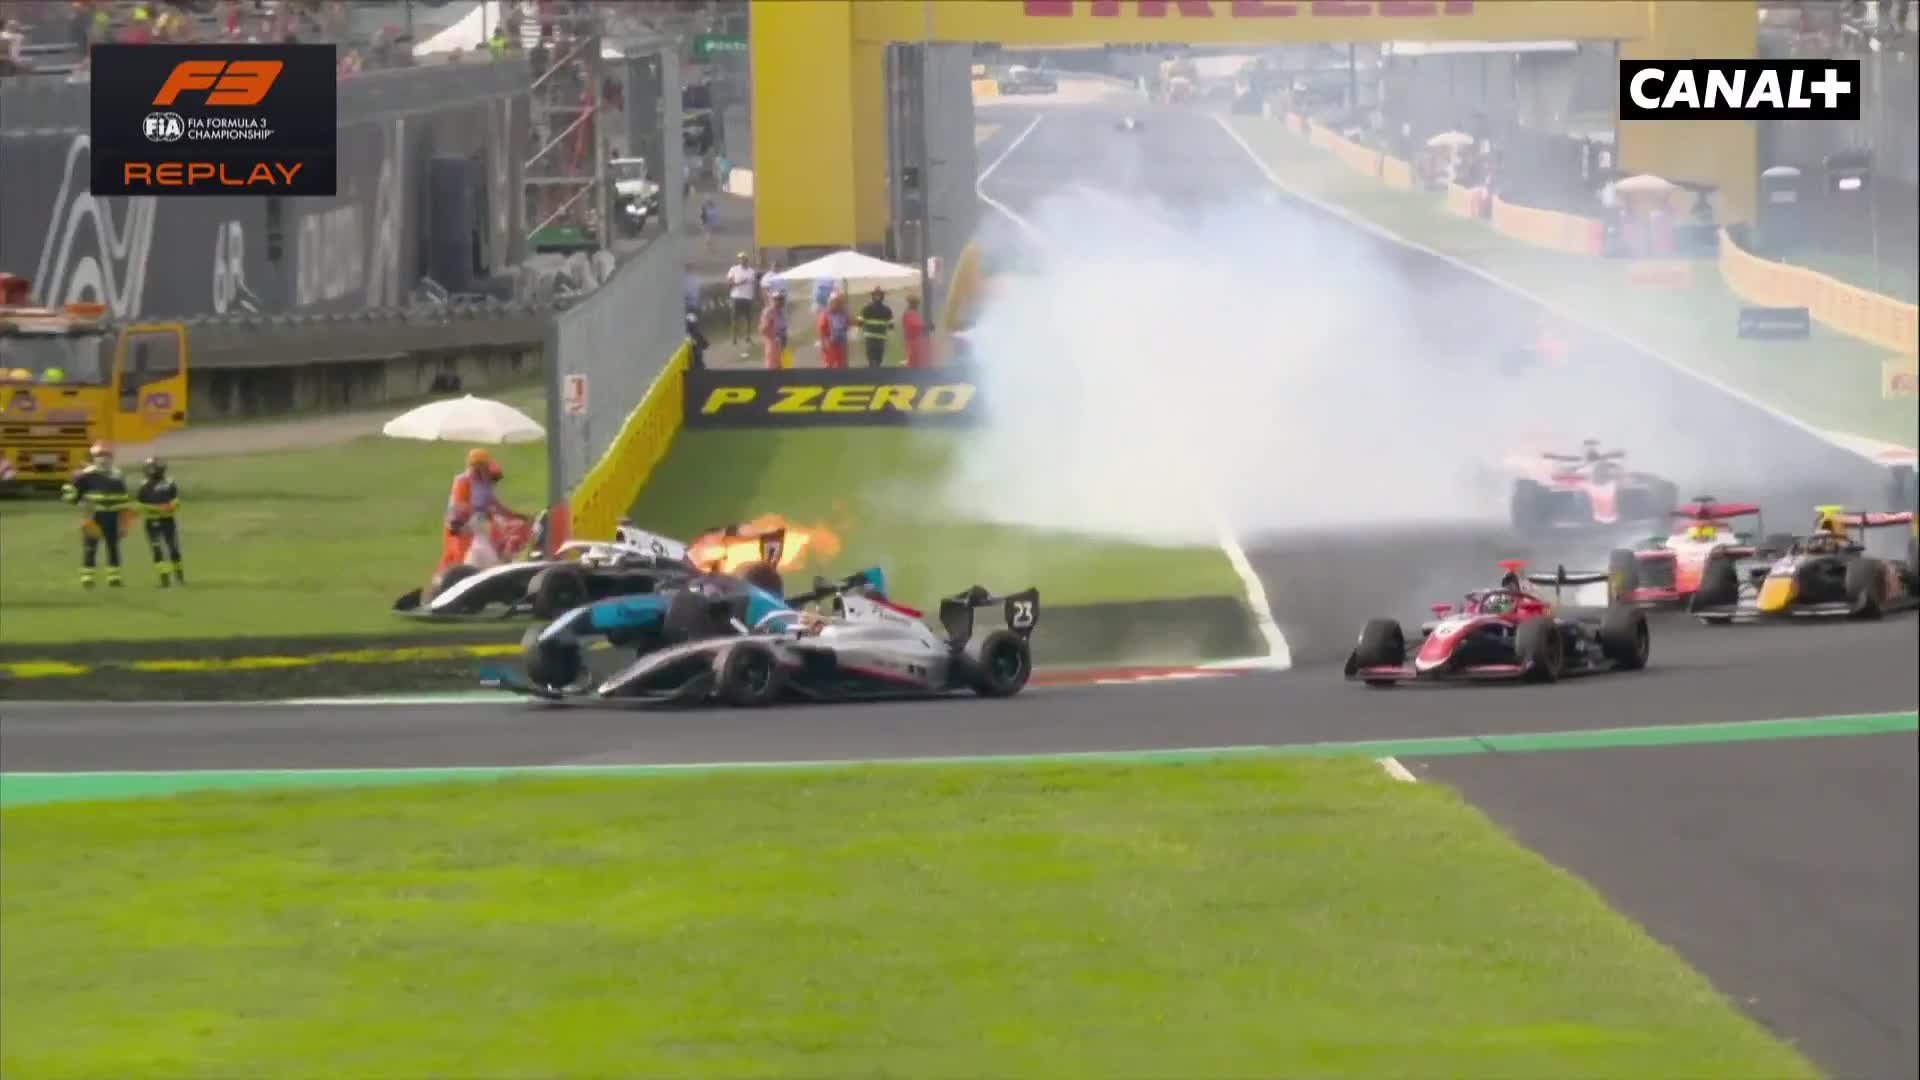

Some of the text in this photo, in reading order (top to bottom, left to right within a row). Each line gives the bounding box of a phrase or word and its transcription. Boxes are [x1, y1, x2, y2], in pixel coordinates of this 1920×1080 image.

[701, 383, 976, 414] P ZERO
[1013, 601, 1033, 628] 23
